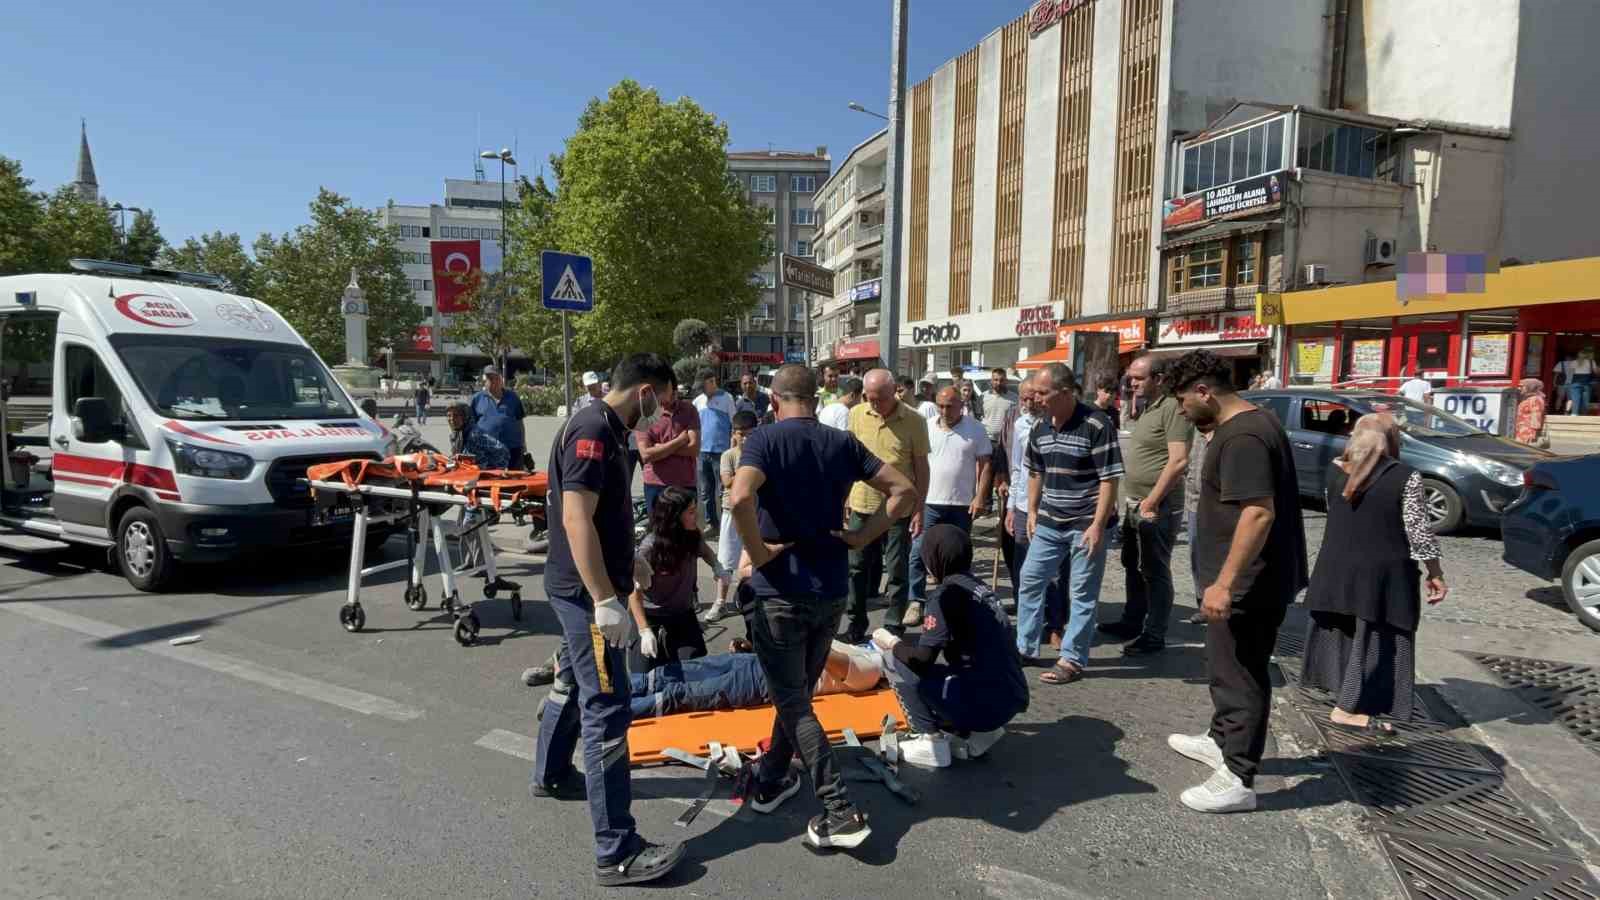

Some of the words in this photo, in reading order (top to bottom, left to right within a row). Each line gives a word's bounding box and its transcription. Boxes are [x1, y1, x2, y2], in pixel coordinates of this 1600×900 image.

[1206, 191, 1215, 200] 10
[1216, 186, 1236, 198] ADET
[1206, 193, 1242, 208] LAHMACUN
[1243, 188, 1265, 200] ALANA
[1020, 305, 1054, 321] HOTEL
[1444, 395, 1487, 415] OTO
